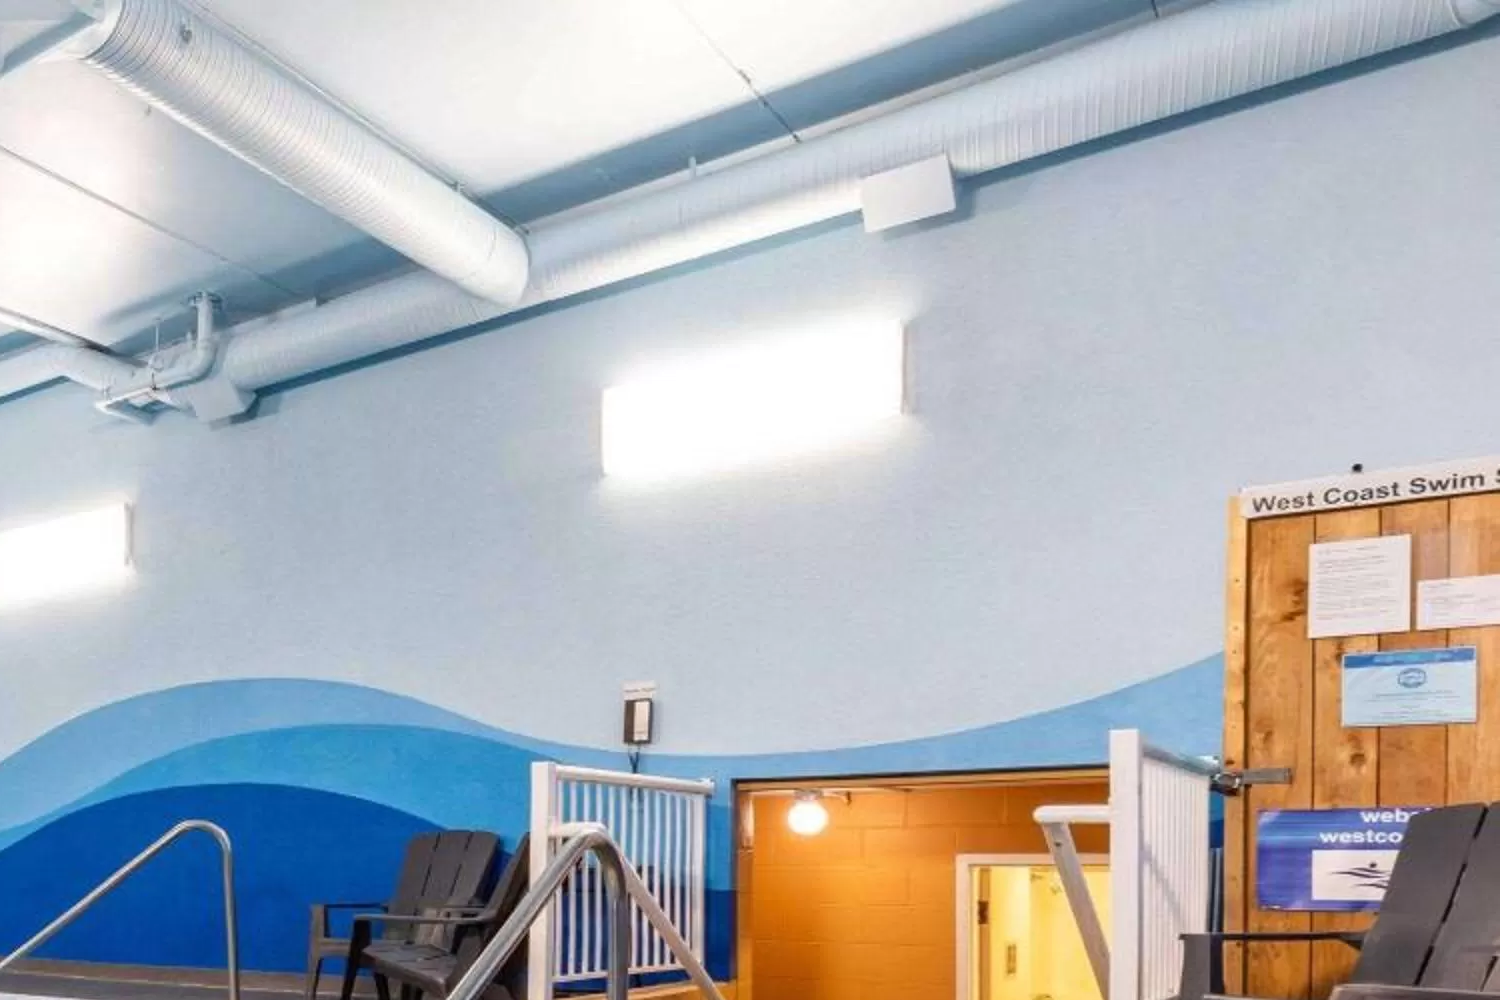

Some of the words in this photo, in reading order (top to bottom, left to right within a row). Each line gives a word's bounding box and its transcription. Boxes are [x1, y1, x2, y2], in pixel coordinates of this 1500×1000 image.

[1252, 490, 1316, 513] West
[1323, 482, 1401, 506] Coast
[1409, 472, 1486, 495] Swim
